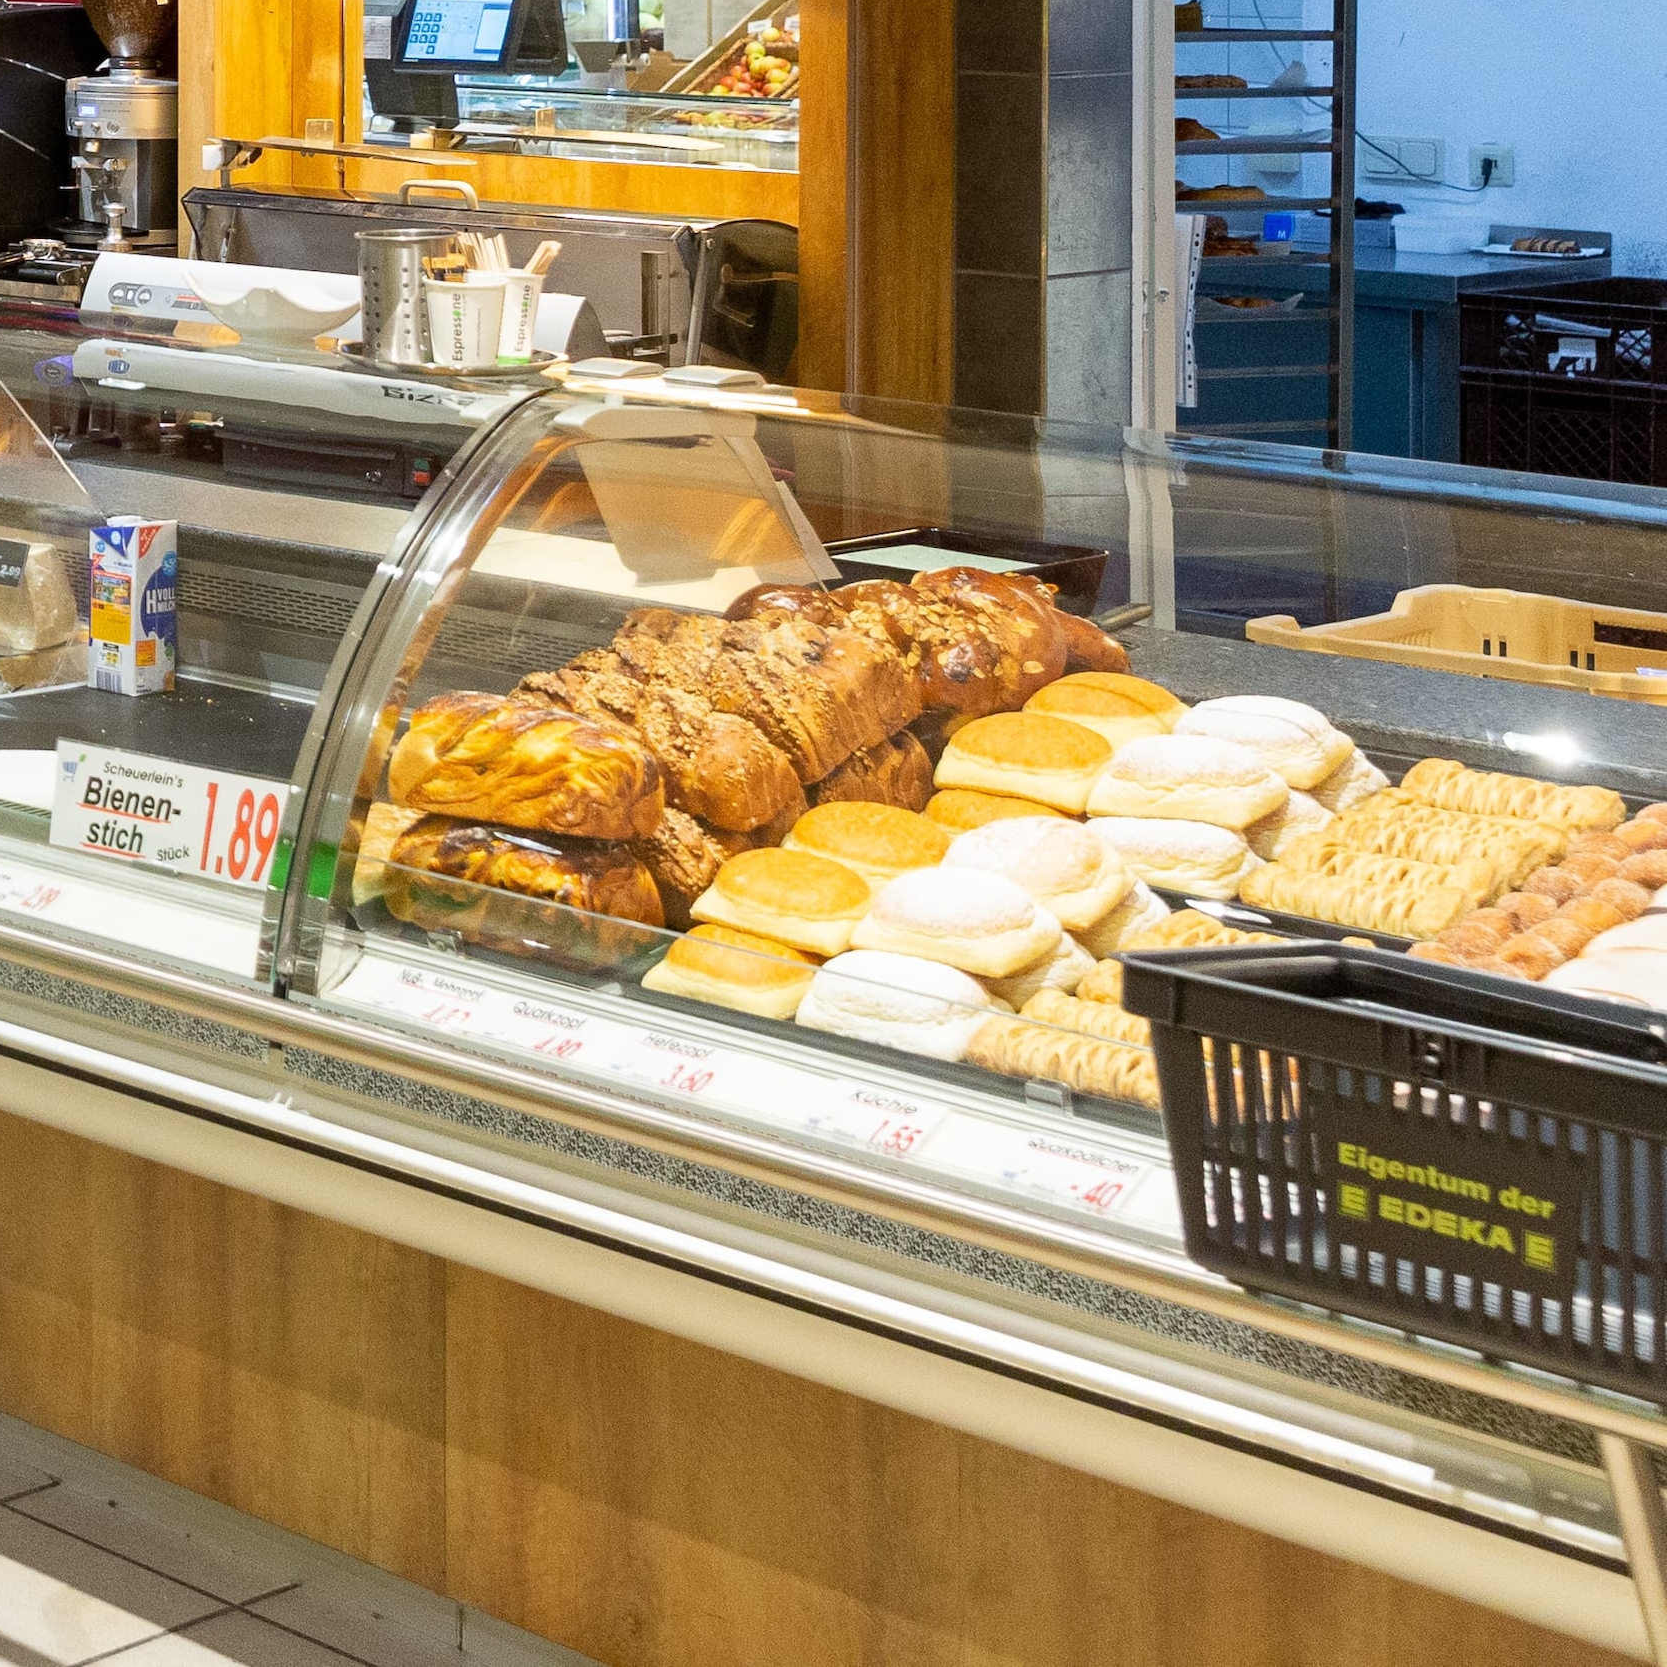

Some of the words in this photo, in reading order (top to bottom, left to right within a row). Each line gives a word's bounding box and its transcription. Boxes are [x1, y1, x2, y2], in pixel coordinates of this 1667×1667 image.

[0, 565, 21, 577] 2.99
[145, 589, 157, 615] H
[157, 587, 176, 602] VOLL
[103, 761, 184, 788] Scheuerlein's
[83, 776, 181, 822] Bienen-
[86, 819, 143, 853] stich
[200, 782, 280, 883] 1.89
[512, 1000, 587, 1031] Quarkzopf
[643, 1032, 717, 1059] Hefezopf
[660, 1064, 715, 1093] 3.60
[868, 1120, 923, 1153] 1.55
[1337, 1140, 1491, 1204] Eigentum
[1496, 1185, 1556, 1221] der
[1378, 1196, 1515, 1255] EDEKA
